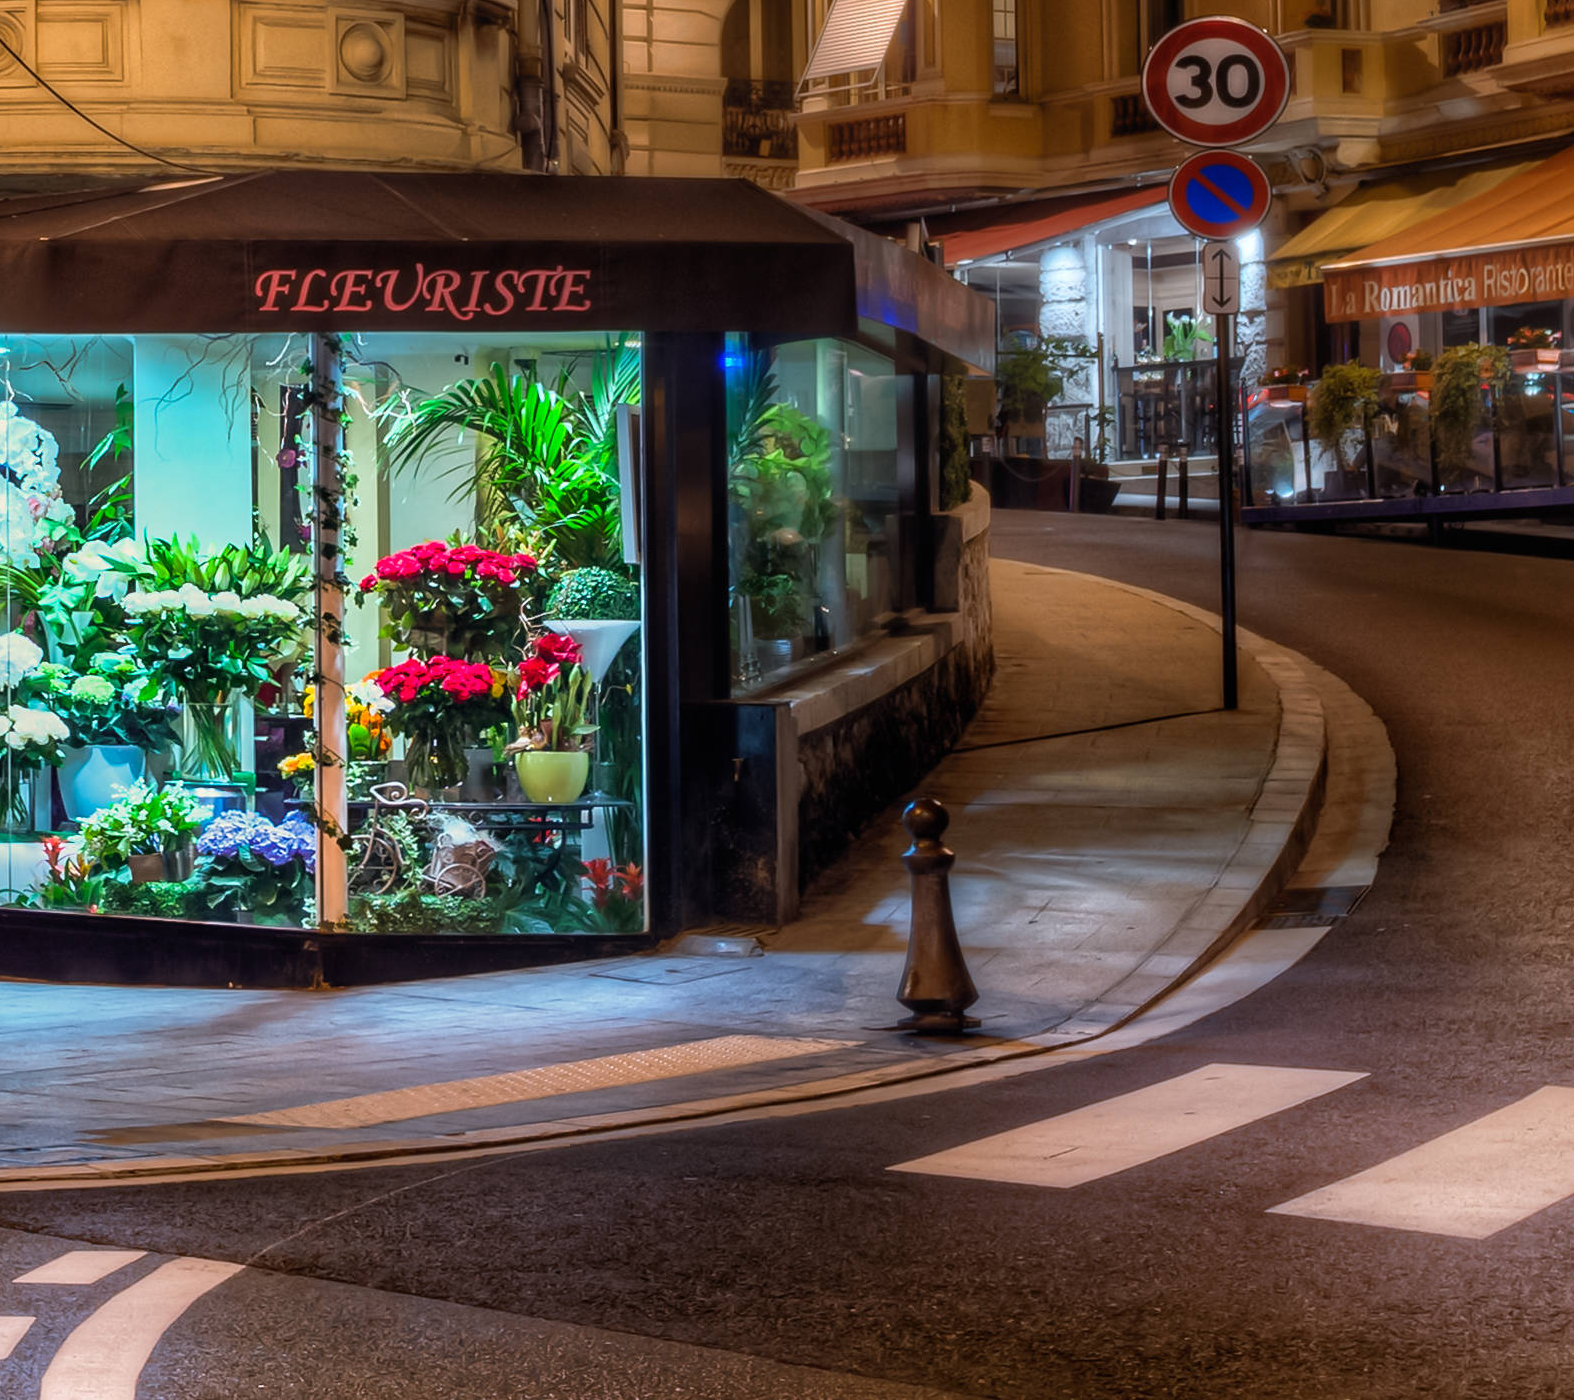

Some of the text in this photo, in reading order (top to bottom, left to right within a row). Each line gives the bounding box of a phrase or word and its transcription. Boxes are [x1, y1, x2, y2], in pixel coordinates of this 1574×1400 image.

[1174, 54, 1261, 109] 30
[254, 262, 592, 321] FLEURISTE
[1330, 284, 1356, 317] La
[1363, 270, 1476, 313] Romantica
[1483, 259, 1574, 300] Ristorante
